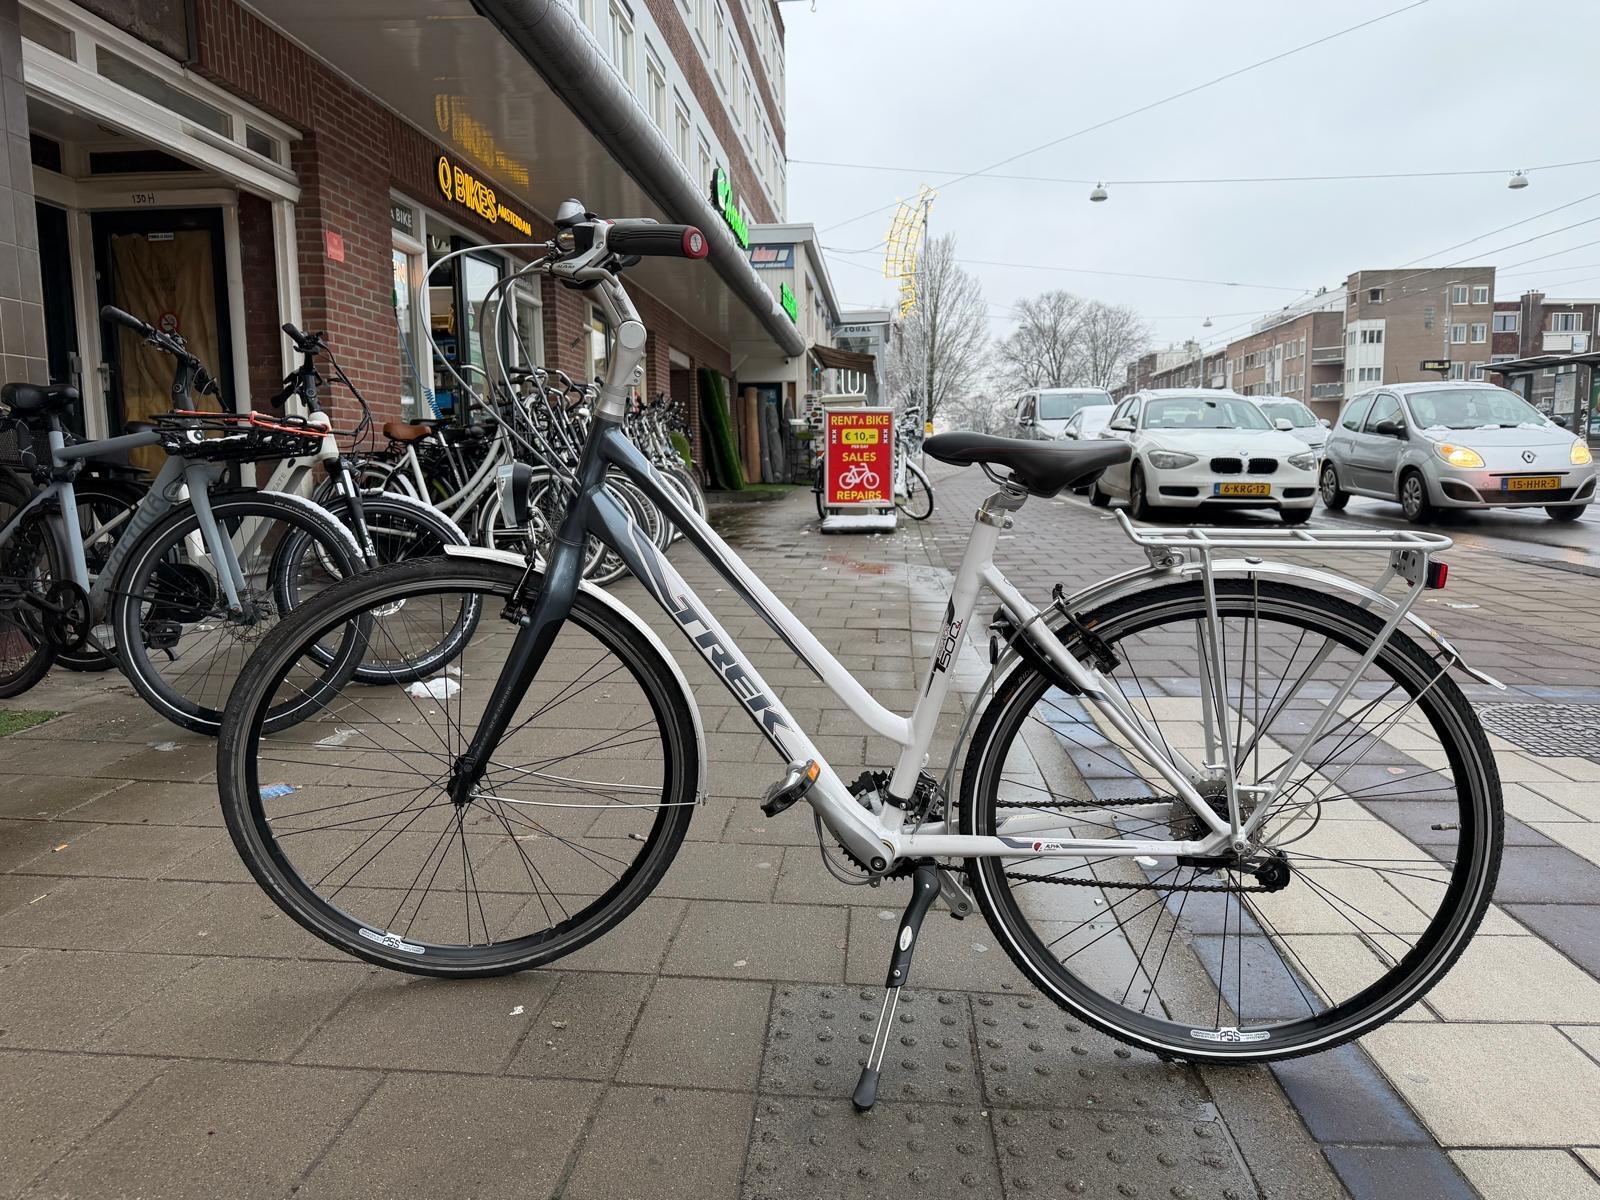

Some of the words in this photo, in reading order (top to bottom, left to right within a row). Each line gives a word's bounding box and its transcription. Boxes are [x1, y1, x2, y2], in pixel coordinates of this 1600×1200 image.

[132, 194, 146, 204] 130
[148, 192, 155, 204] H
[438, 156, 452, 200] Q
[454, 166, 497, 224] BIKES
[497, 203, 532, 237] AMSTERDAM
[395, 207, 412, 228] BIKE
[831, 415, 857, 425] RENT
[866, 415, 889, 425] BIKE
[842, 452, 876, 462] SALES
[1223, 484, 1267, 494] 6-KRG-12
[1512, 478, 1557, 489] 15-HHR-3
[836, 490, 881, 499] REPAIRS
[675, 594, 794, 736] TREK
[382, 936, 400, 949] PSS
[1220, 1030, 1240, 1042] PSS
